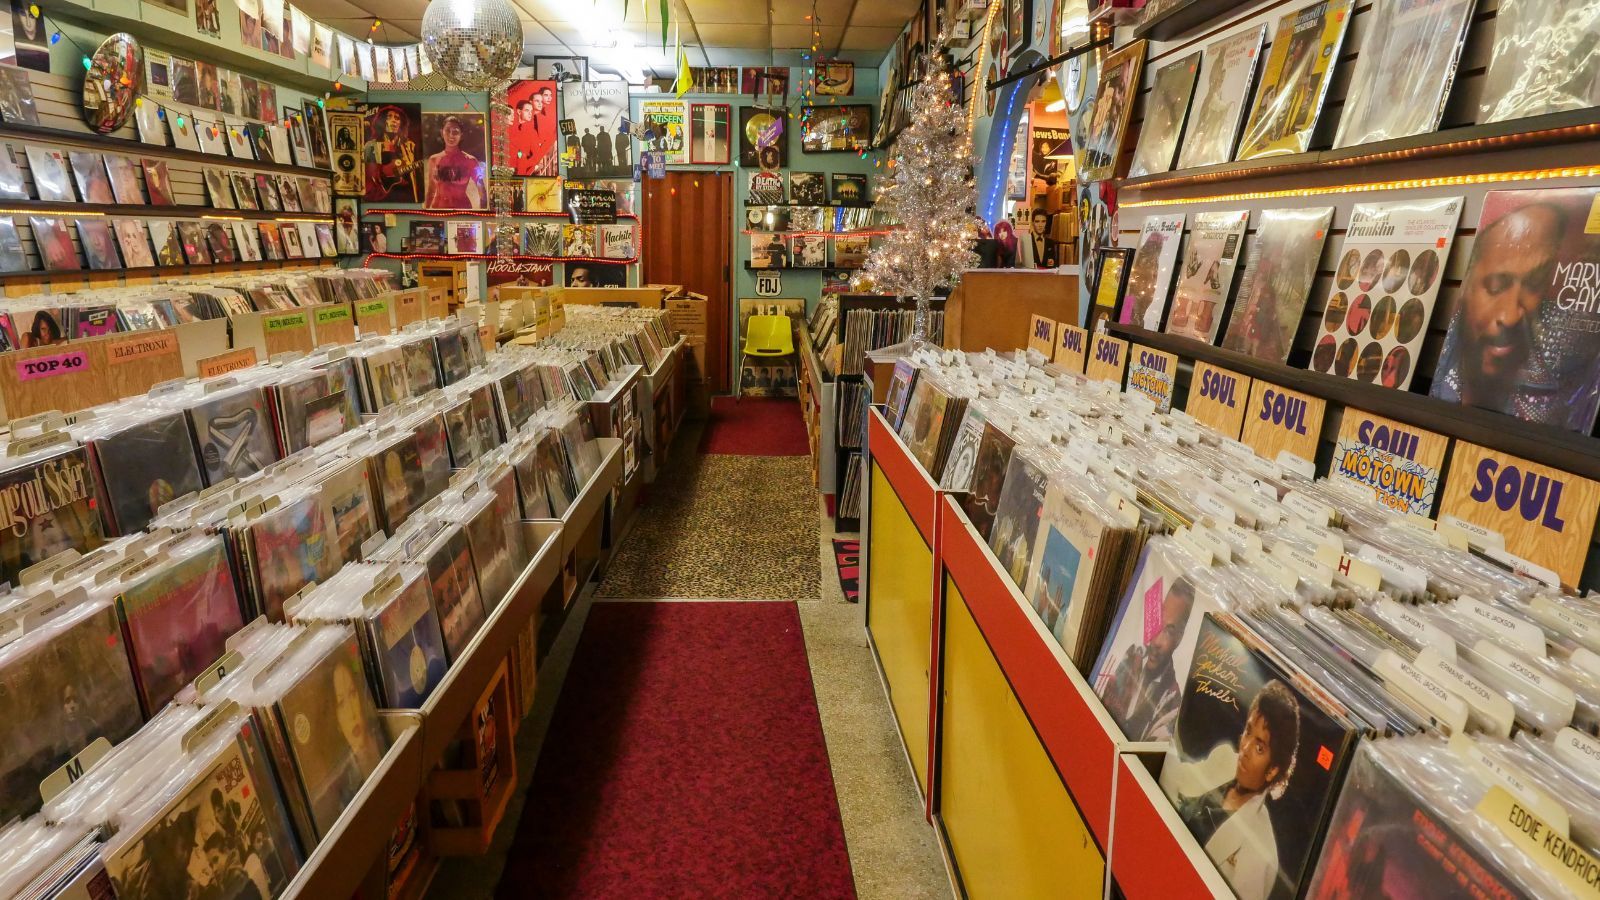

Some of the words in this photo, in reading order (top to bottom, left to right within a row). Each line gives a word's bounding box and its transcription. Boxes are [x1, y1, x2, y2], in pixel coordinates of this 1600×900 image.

[586, 88, 622, 97] DIVISION
[1348, 222, 1394, 238] franklin
[486, 262, 553, 274] HOOBASTANK
[759, 278, 778, 294] FDJ
[1035, 319, 1050, 342] SOUL
[1063, 328, 1081, 353] SOUL
[114, 340, 169, 358] ELECTRONIC
[1096, 339, 1119, 366] SOUL
[25, 360, 59, 374] TOP
[62, 356, 82, 368] 40
[208, 358, 250, 376] ELECTRONIC
[1132, 372, 1169, 398] MOTOWN
[1200, 369, 1237, 408] SOUL
[1260, 390, 1307, 436] SOUL
[43, 459, 88, 510] Sister
[1340, 450, 1425, 503] MOTOWN
[1470, 458, 1565, 533] SOUL
[1469, 525, 1488, 536] JACKSON
[1338, 556, 1351, 576] H
[1400, 614, 1421, 630] JACKSON
[1474, 606, 1490, 619] MILLIE
[1490, 614, 1516, 630] JACKSON
[1200, 630, 1248, 673] Michael
[1192, 654, 1248, 690] Jackson
[1400, 663, 1422, 686] MICHAEL
[1422, 678, 1448, 701] JACKSON
[1509, 661, 1541, 684] JACKSONS
[1196, 680, 1239, 712] Thriller
[1464, 679, 1490, 700] JACKSON
[1571, 738, 1600, 761] GLADYS
[65, 758, 83, 784] M
[1509, 804, 1543, 842] EDDIE
